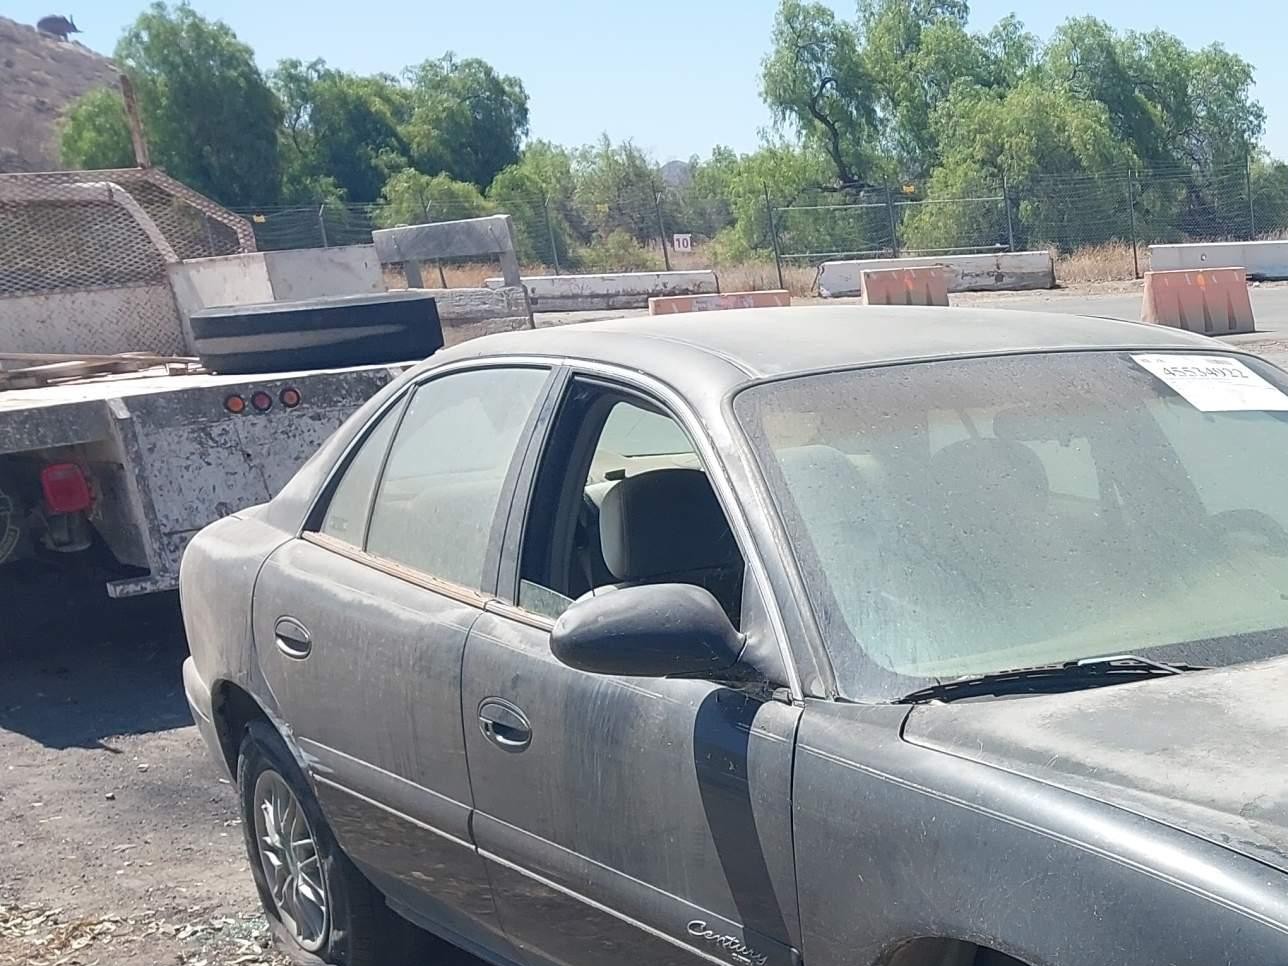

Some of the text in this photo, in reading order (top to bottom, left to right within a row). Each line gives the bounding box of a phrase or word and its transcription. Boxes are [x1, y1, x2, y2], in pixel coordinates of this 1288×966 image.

[675, 237, 689, 249] 10
[1162, 366, 1249, 379] 45534922
[687, 919, 768, 966] Century
